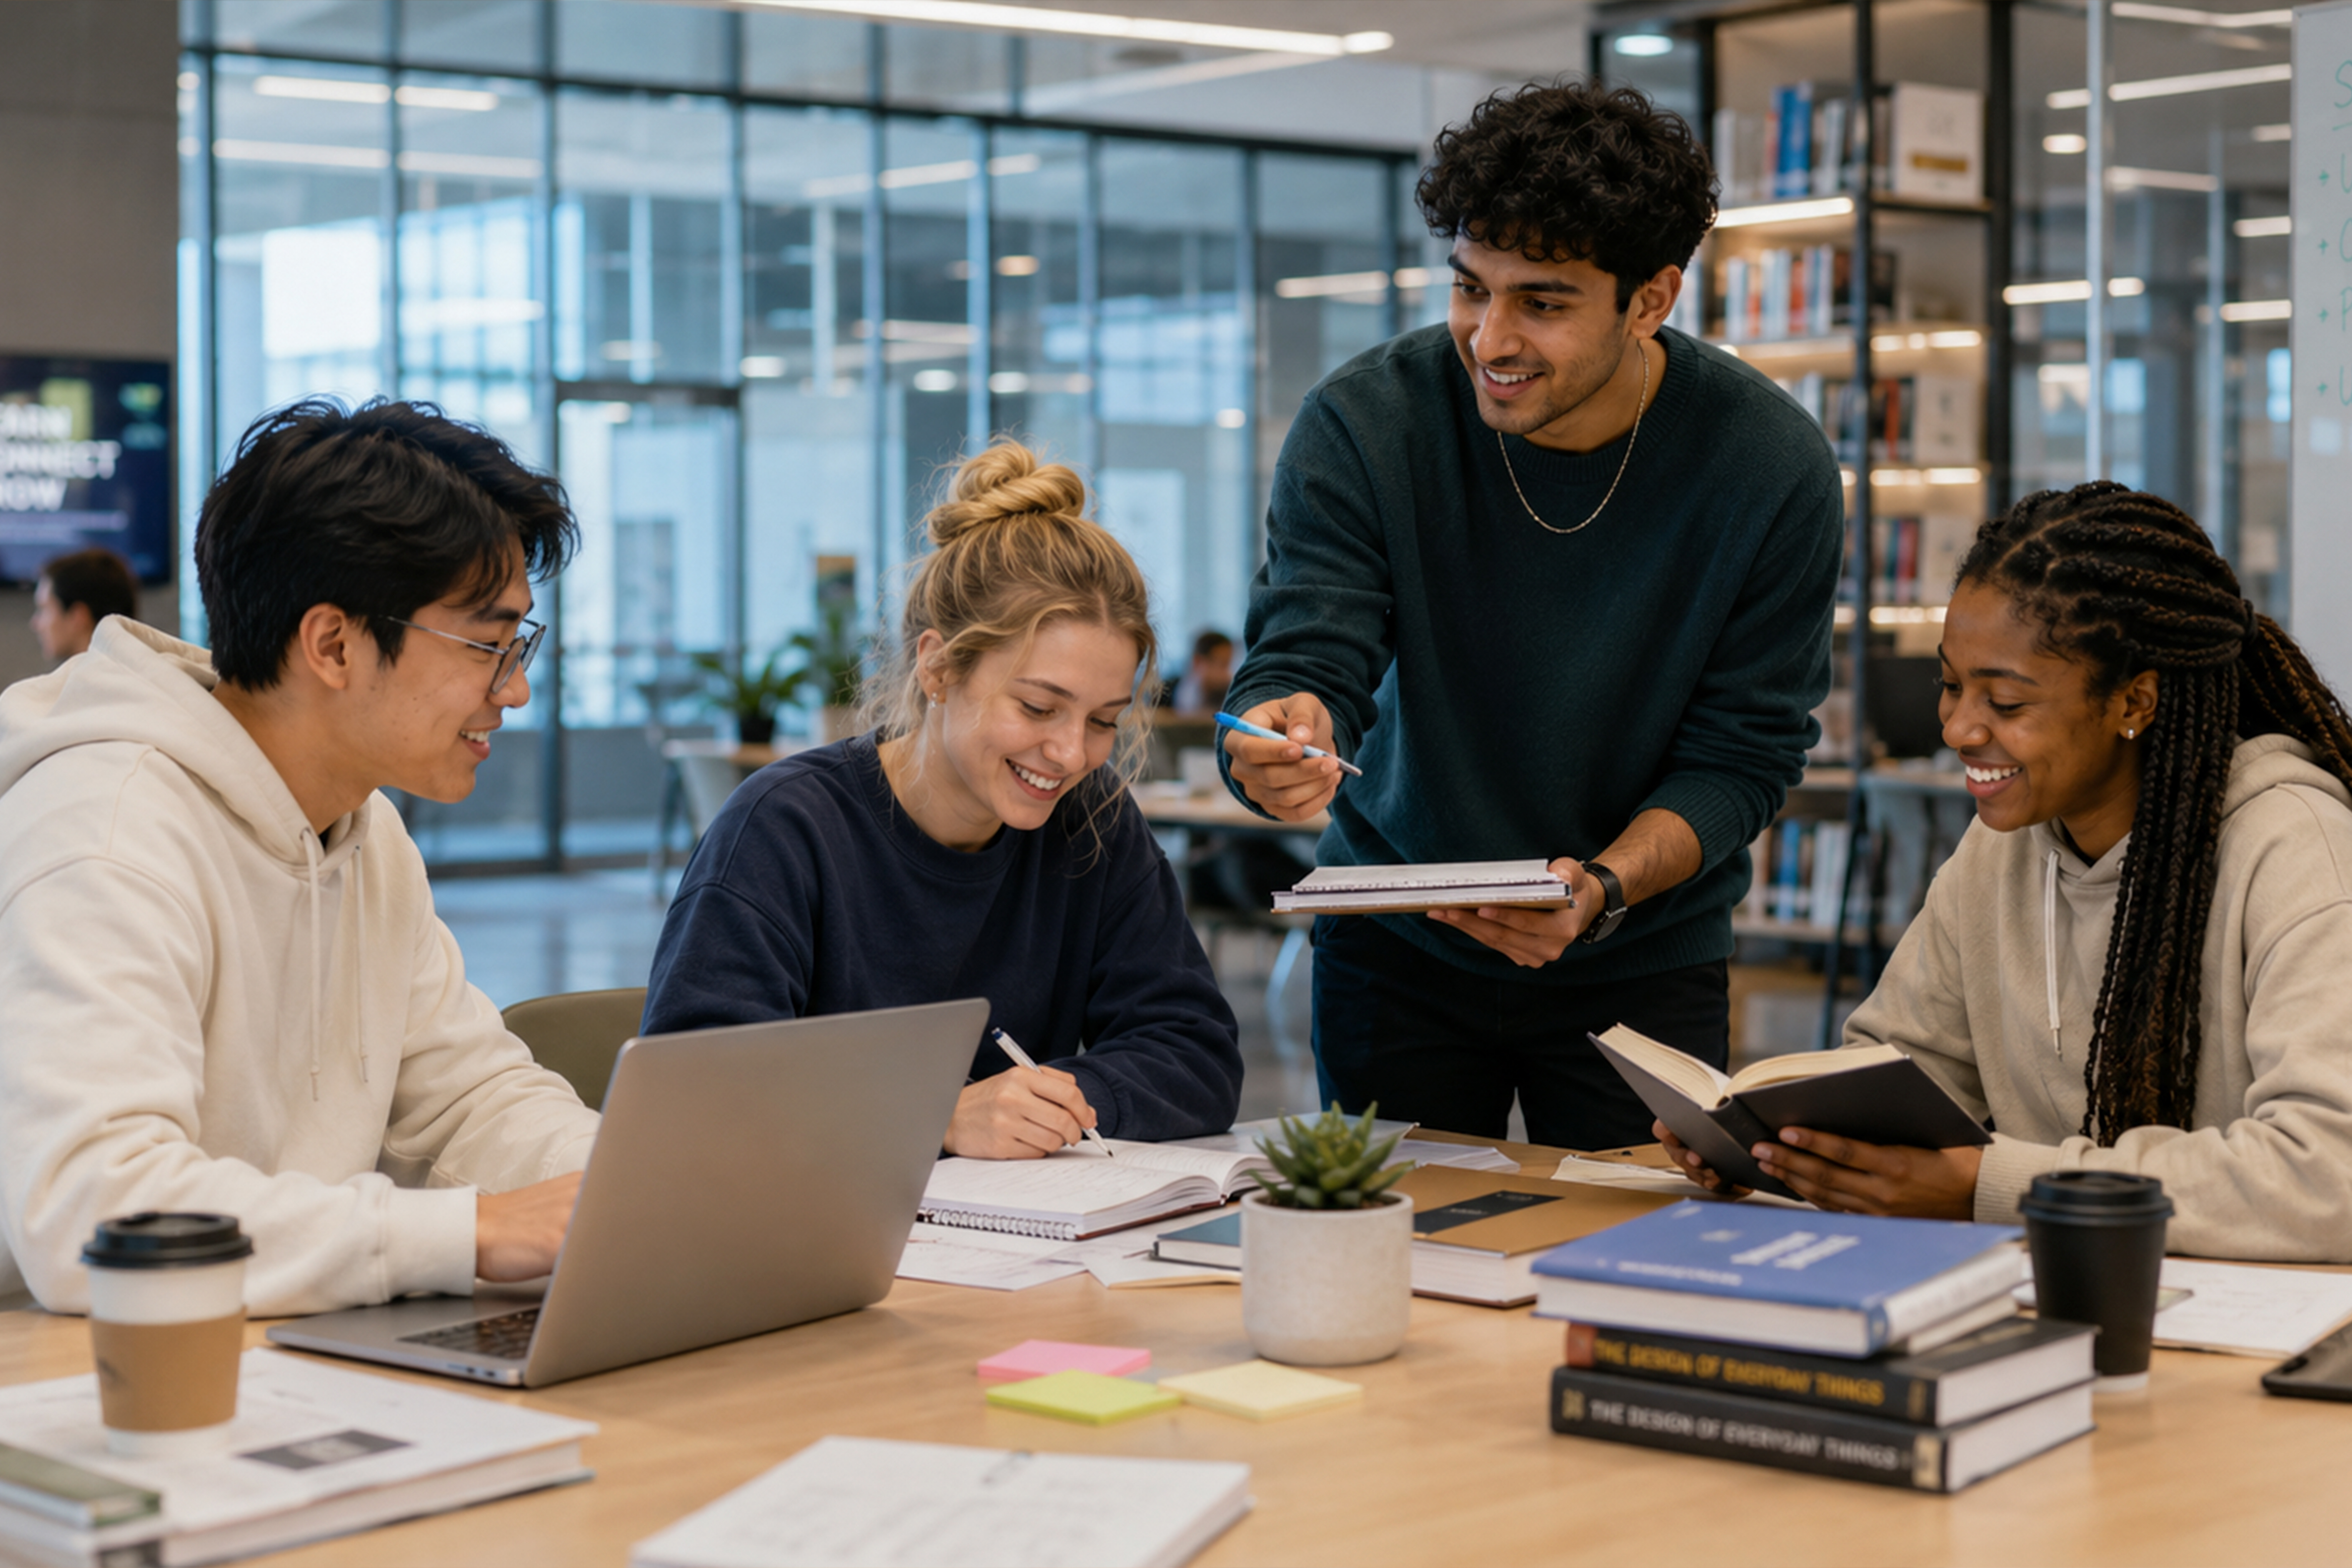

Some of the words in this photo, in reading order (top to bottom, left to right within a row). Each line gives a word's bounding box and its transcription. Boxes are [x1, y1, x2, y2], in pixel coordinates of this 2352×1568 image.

[1594, 1339, 1627, 1365] THE
[1629, 1344, 1693, 1376] DESIGN
[1695, 1354, 1722, 1379] OF
[1723, 1358, 1812, 1394] EVERYDAY
[1814, 1372, 1884, 1407] THINGS
[1590, 1399, 1625, 1426] THE
[1627, 1405, 1694, 1437] DESIGN
[1696, 1416, 1722, 1440] OF
[1723, 1420, 1822, 1458] EVERYDAY
[1824, 1437, 1899, 1471] THINGS
